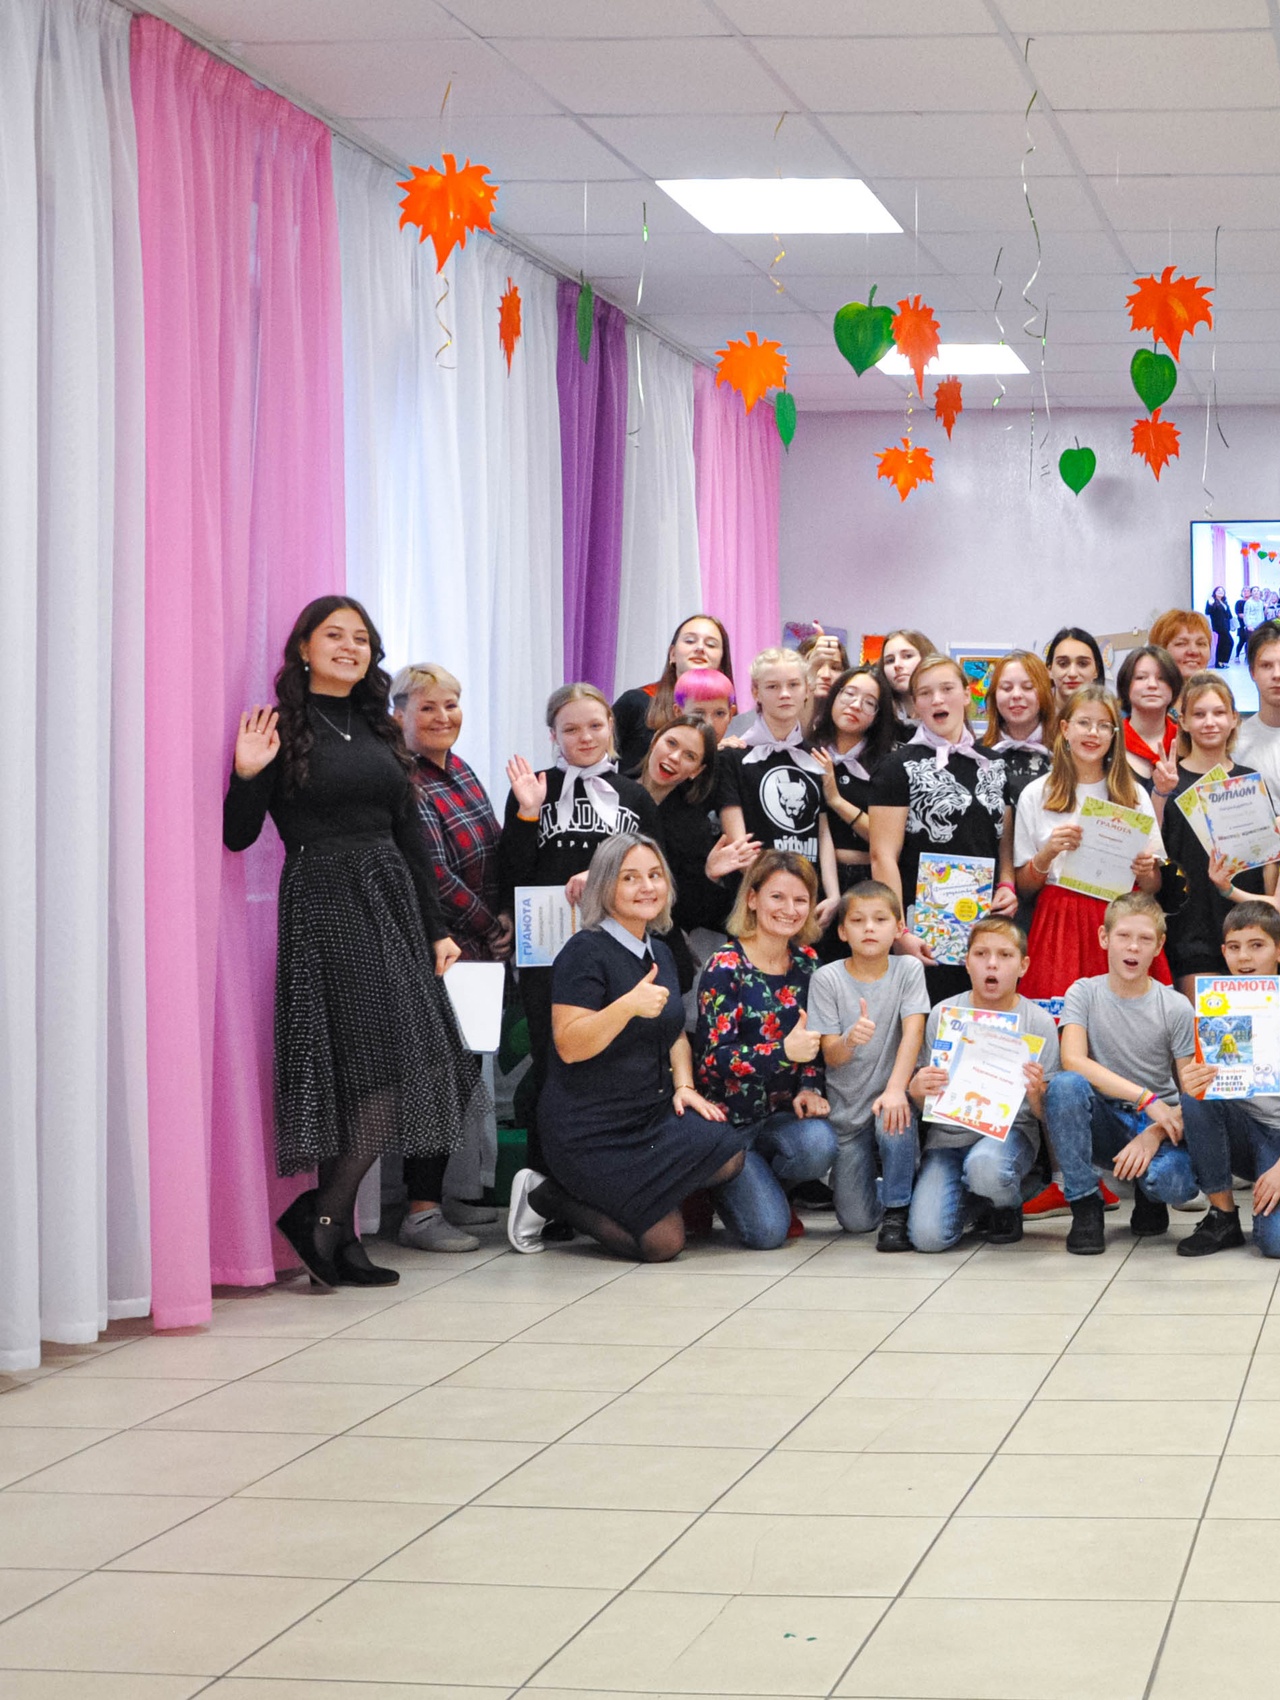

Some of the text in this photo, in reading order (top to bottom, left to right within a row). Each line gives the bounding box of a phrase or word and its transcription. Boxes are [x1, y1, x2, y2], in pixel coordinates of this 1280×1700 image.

[1208, 785, 1256, 803] ДИПЛОМ
[1096, 819, 1132, 835] ГРАМОТА
[521, 897, 533, 956] ГРАМОТА
[1213, 979, 1277, 992] ГРАМОТА
